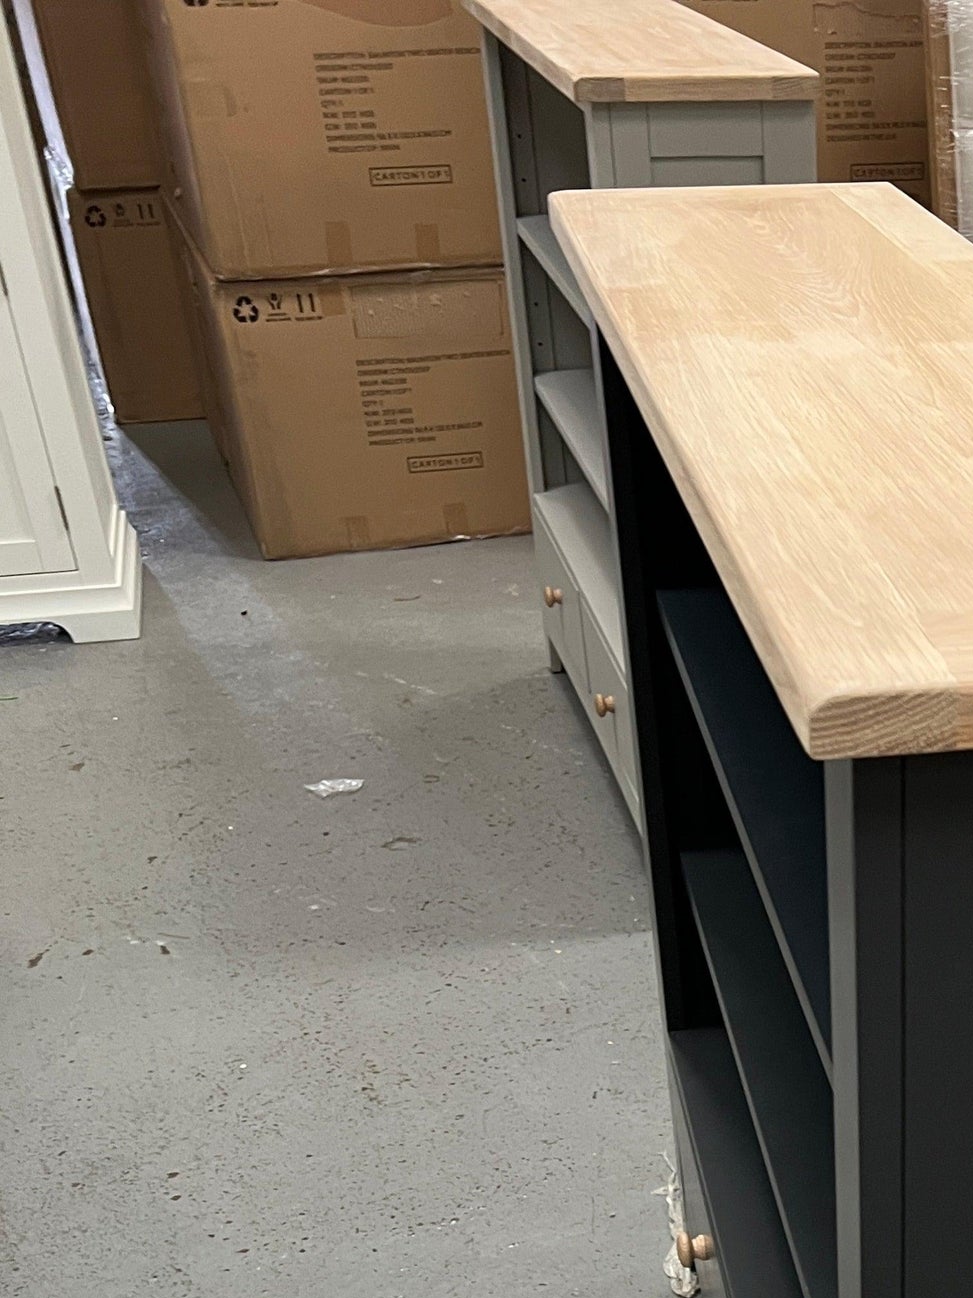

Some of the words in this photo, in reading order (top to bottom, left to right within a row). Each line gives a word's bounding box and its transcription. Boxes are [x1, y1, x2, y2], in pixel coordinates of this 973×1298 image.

[373, 171, 418, 181] CARTON
[428, 170, 442, 179] OF
[411, 459, 453, 469] CARTON
